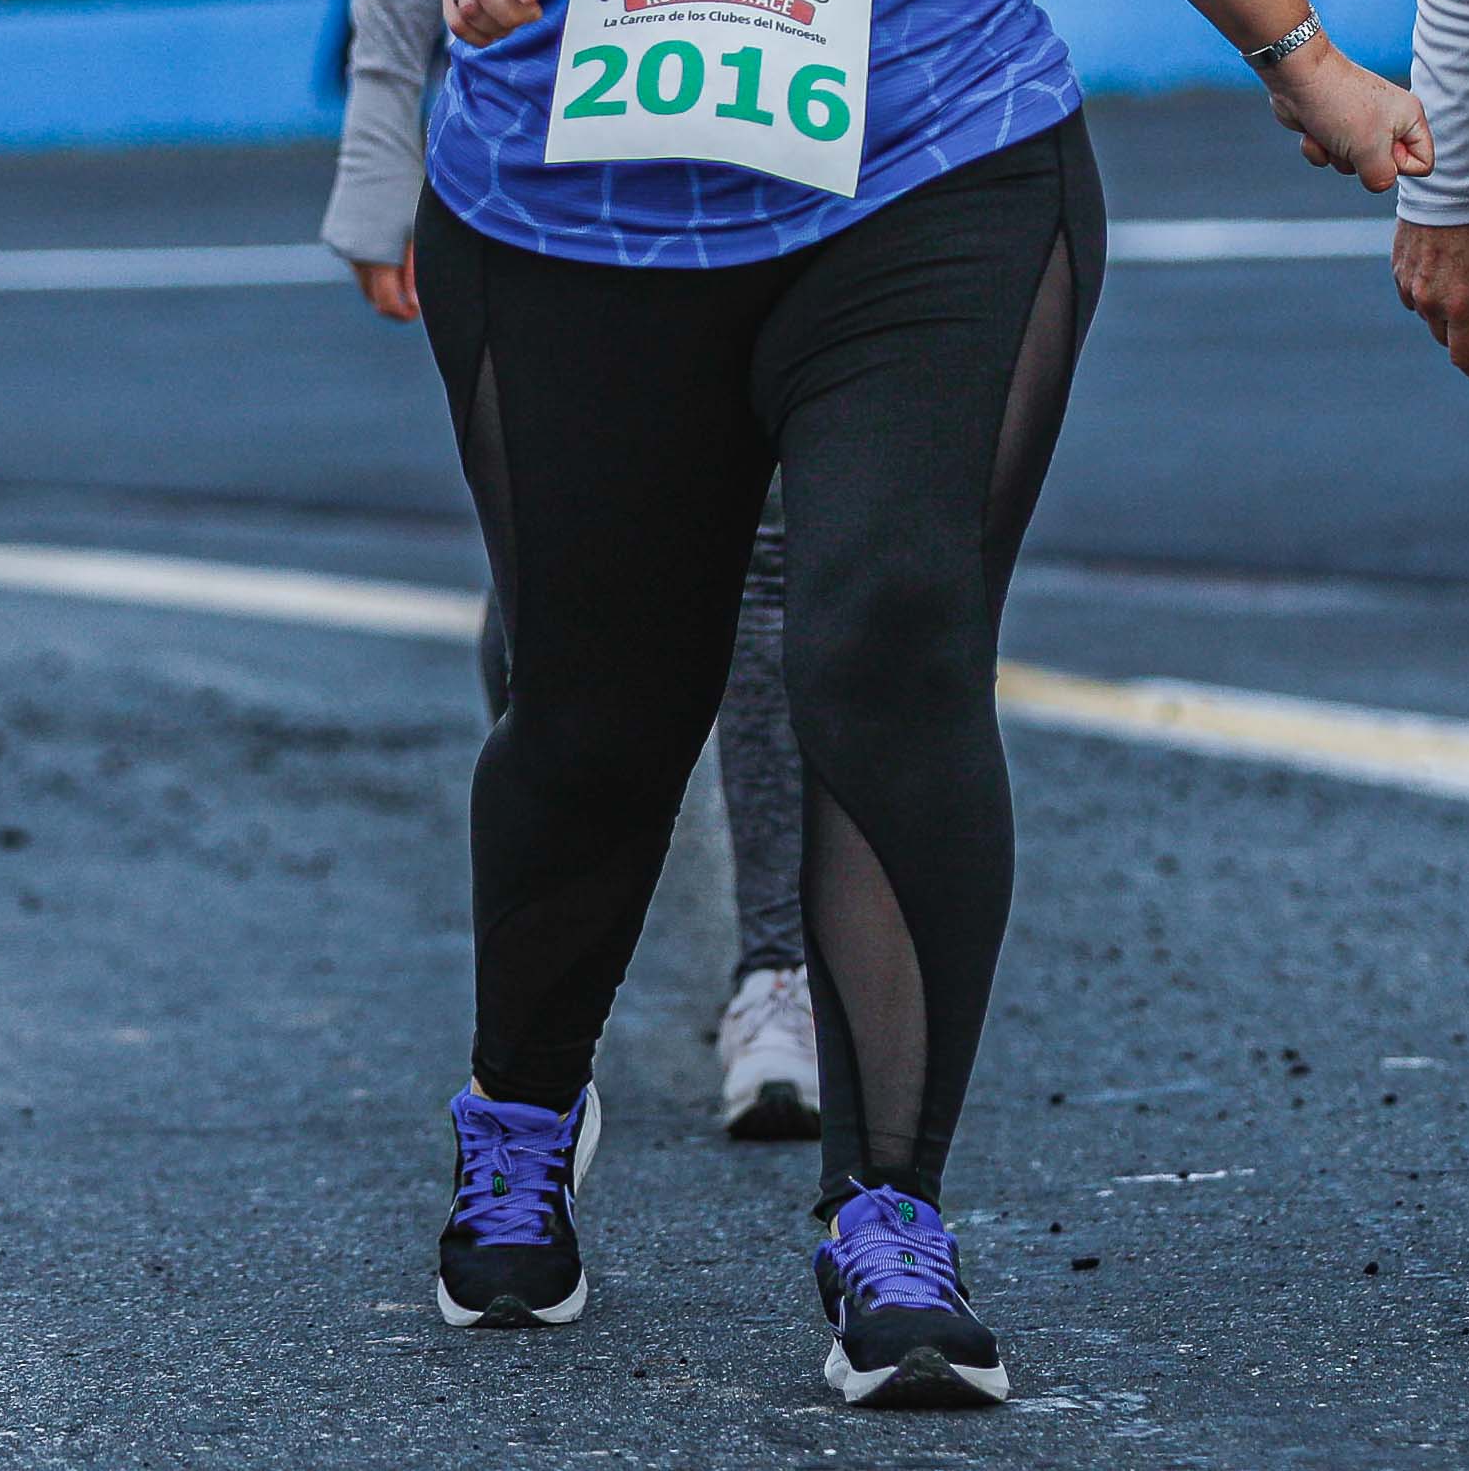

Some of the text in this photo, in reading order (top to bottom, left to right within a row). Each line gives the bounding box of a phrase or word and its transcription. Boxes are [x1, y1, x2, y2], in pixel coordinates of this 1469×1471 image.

[604, 10, 827, 45] La Carrera de los Clubes del Noroeste
[563, 39, 851, 142] 2016
